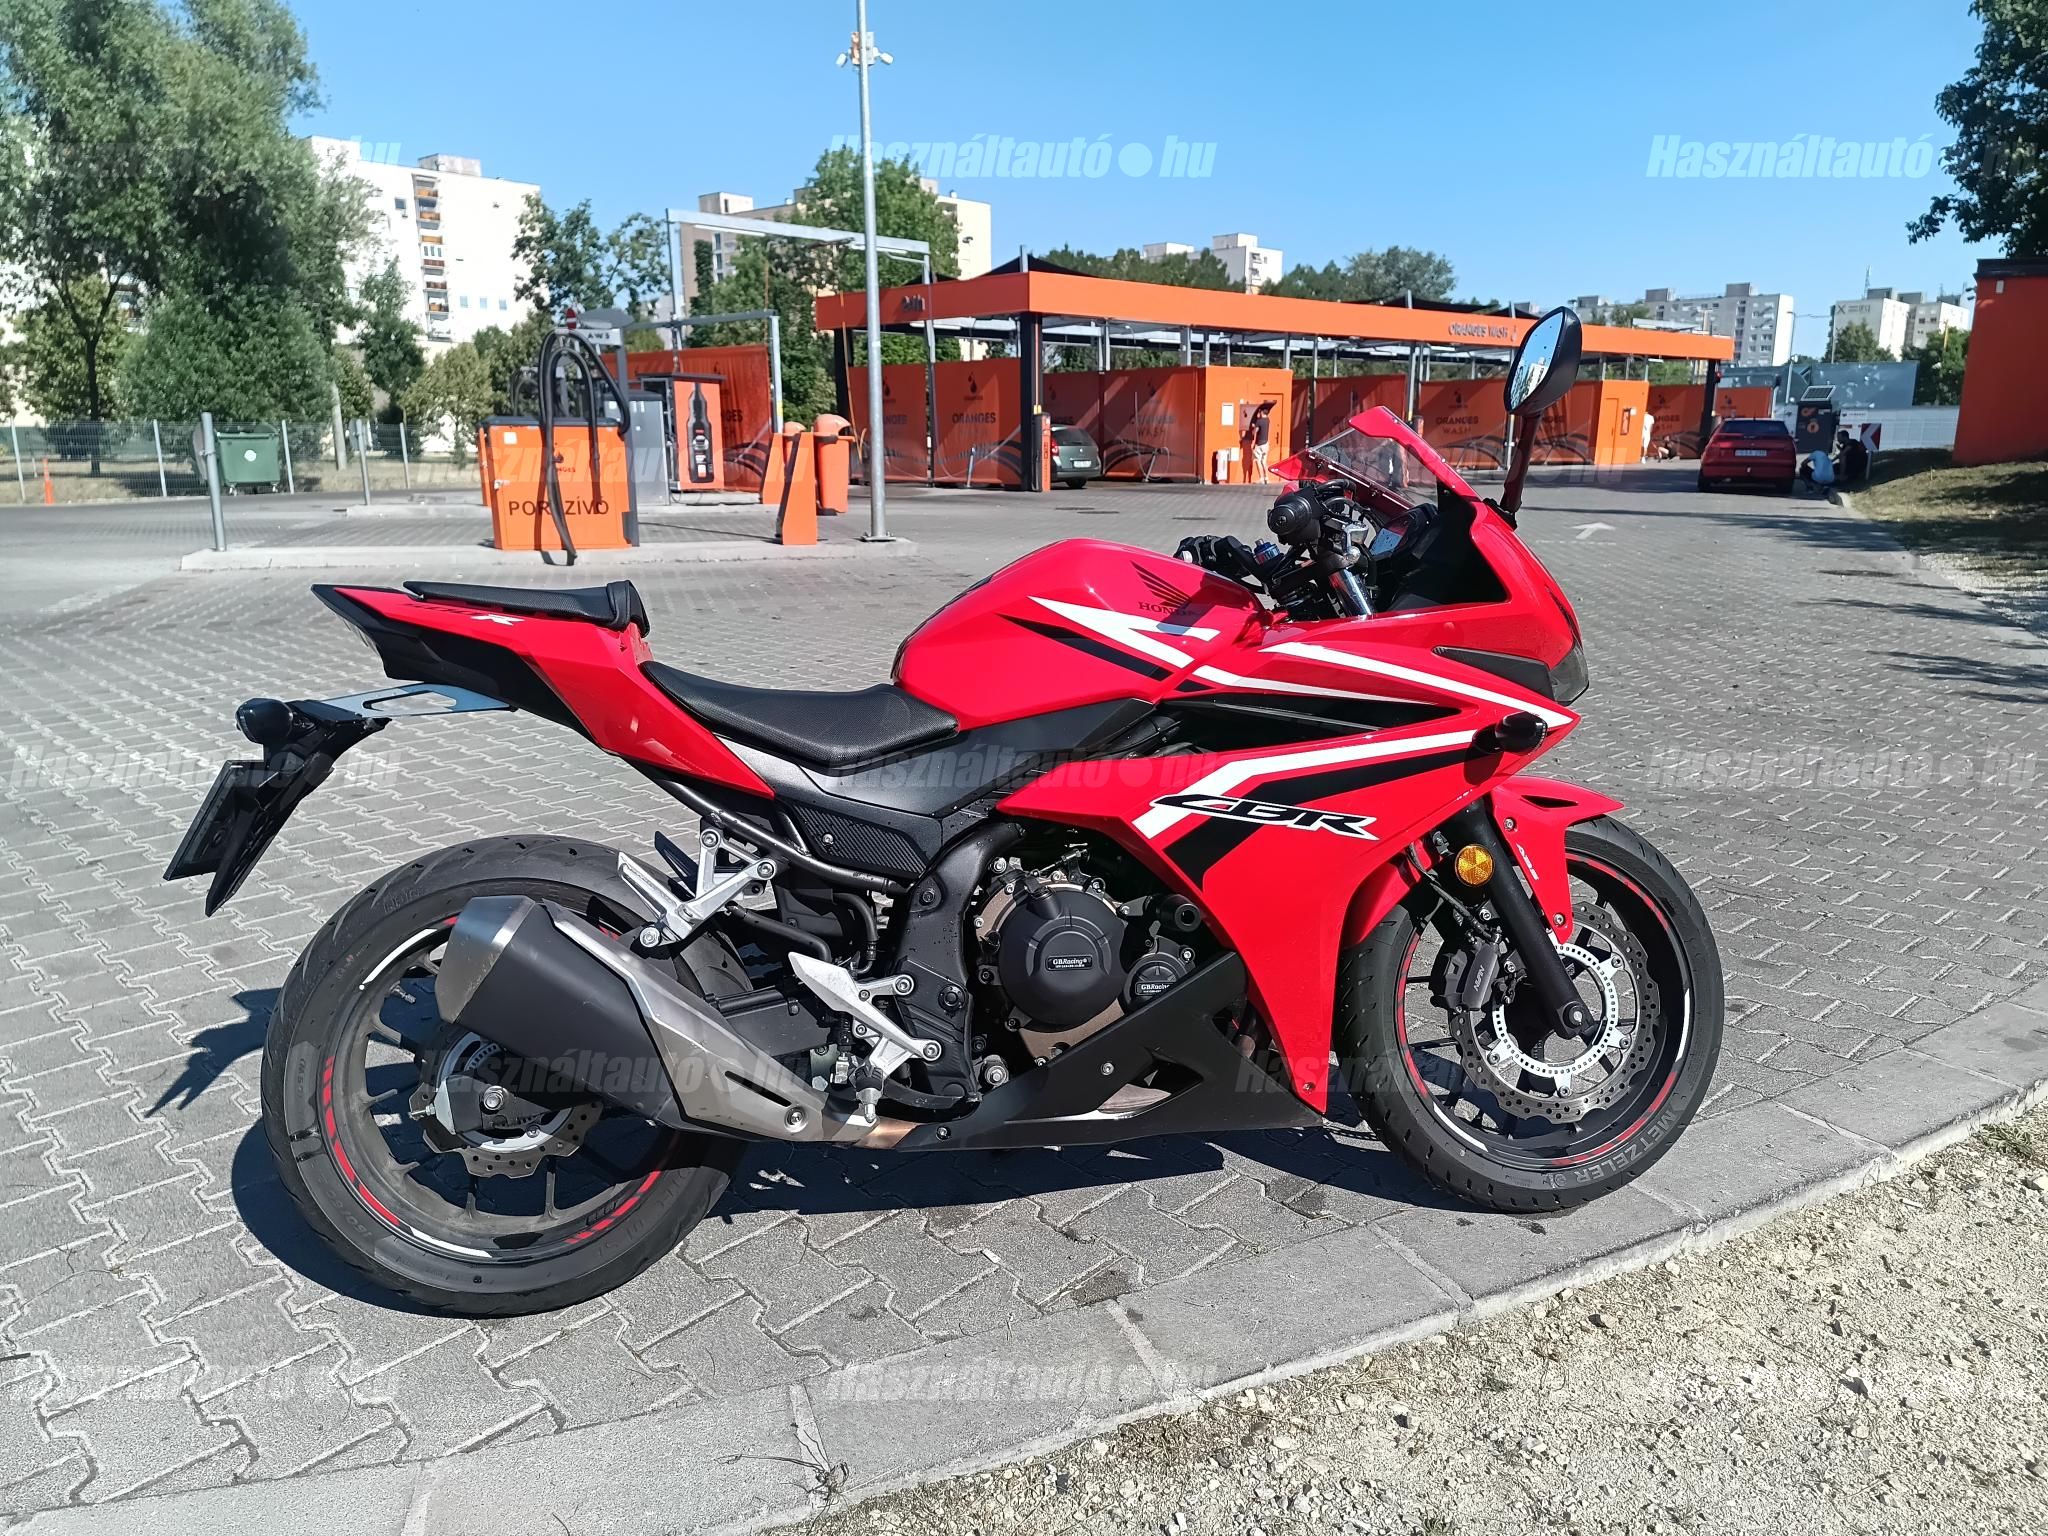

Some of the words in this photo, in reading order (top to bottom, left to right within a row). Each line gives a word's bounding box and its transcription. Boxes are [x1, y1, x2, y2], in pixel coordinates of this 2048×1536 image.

[951, 412, 997, 425] ORANGES
[1435, 415, 1479, 425] ORANGES
[508, 495, 609, 516] PORZÍVÓ
[1149, 794, 1381, 841] CBR
[1572, 1110, 1677, 1184] METZELER
